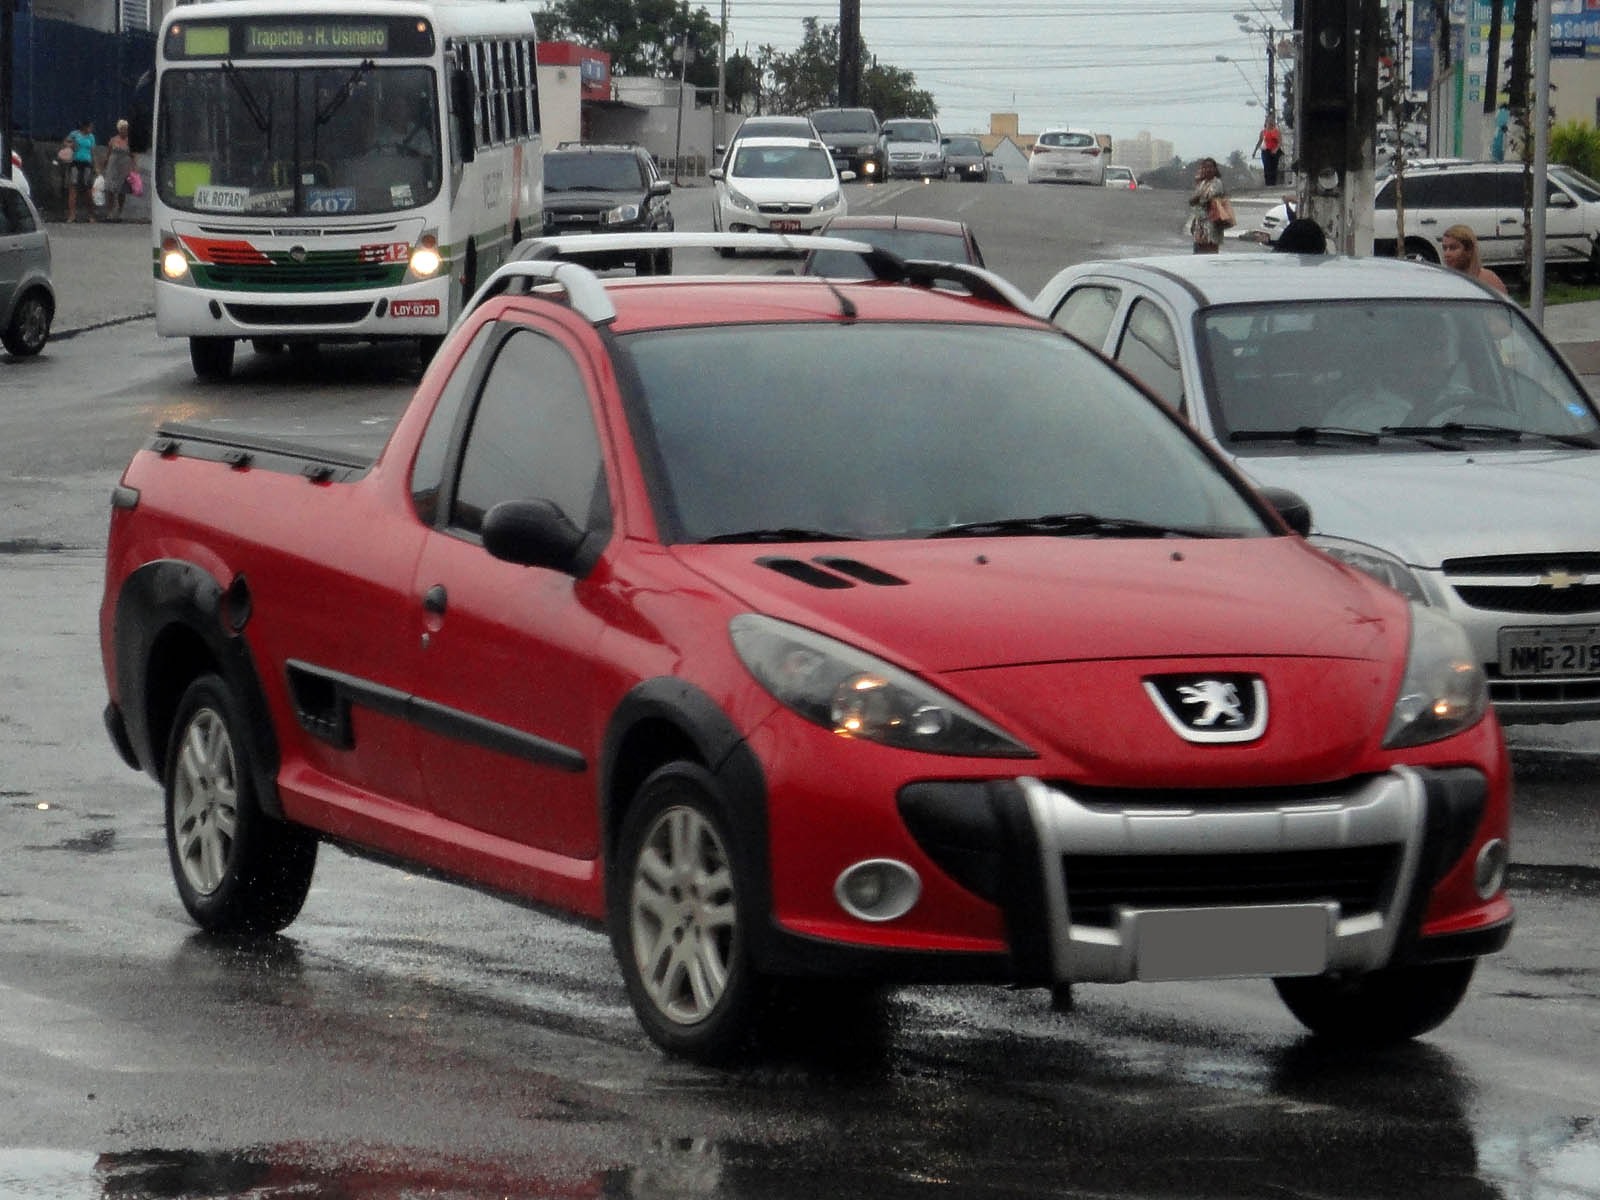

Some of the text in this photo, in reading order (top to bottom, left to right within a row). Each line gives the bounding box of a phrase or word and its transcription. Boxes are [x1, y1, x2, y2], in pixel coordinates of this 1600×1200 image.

[250, 27, 303, 48] Trapiche
[315, 27, 329, 45] H.
[332, 26, 385, 46] Usineiro
[211, 191, 246, 207] ROTARY
[310, 198, 353, 213] 407
